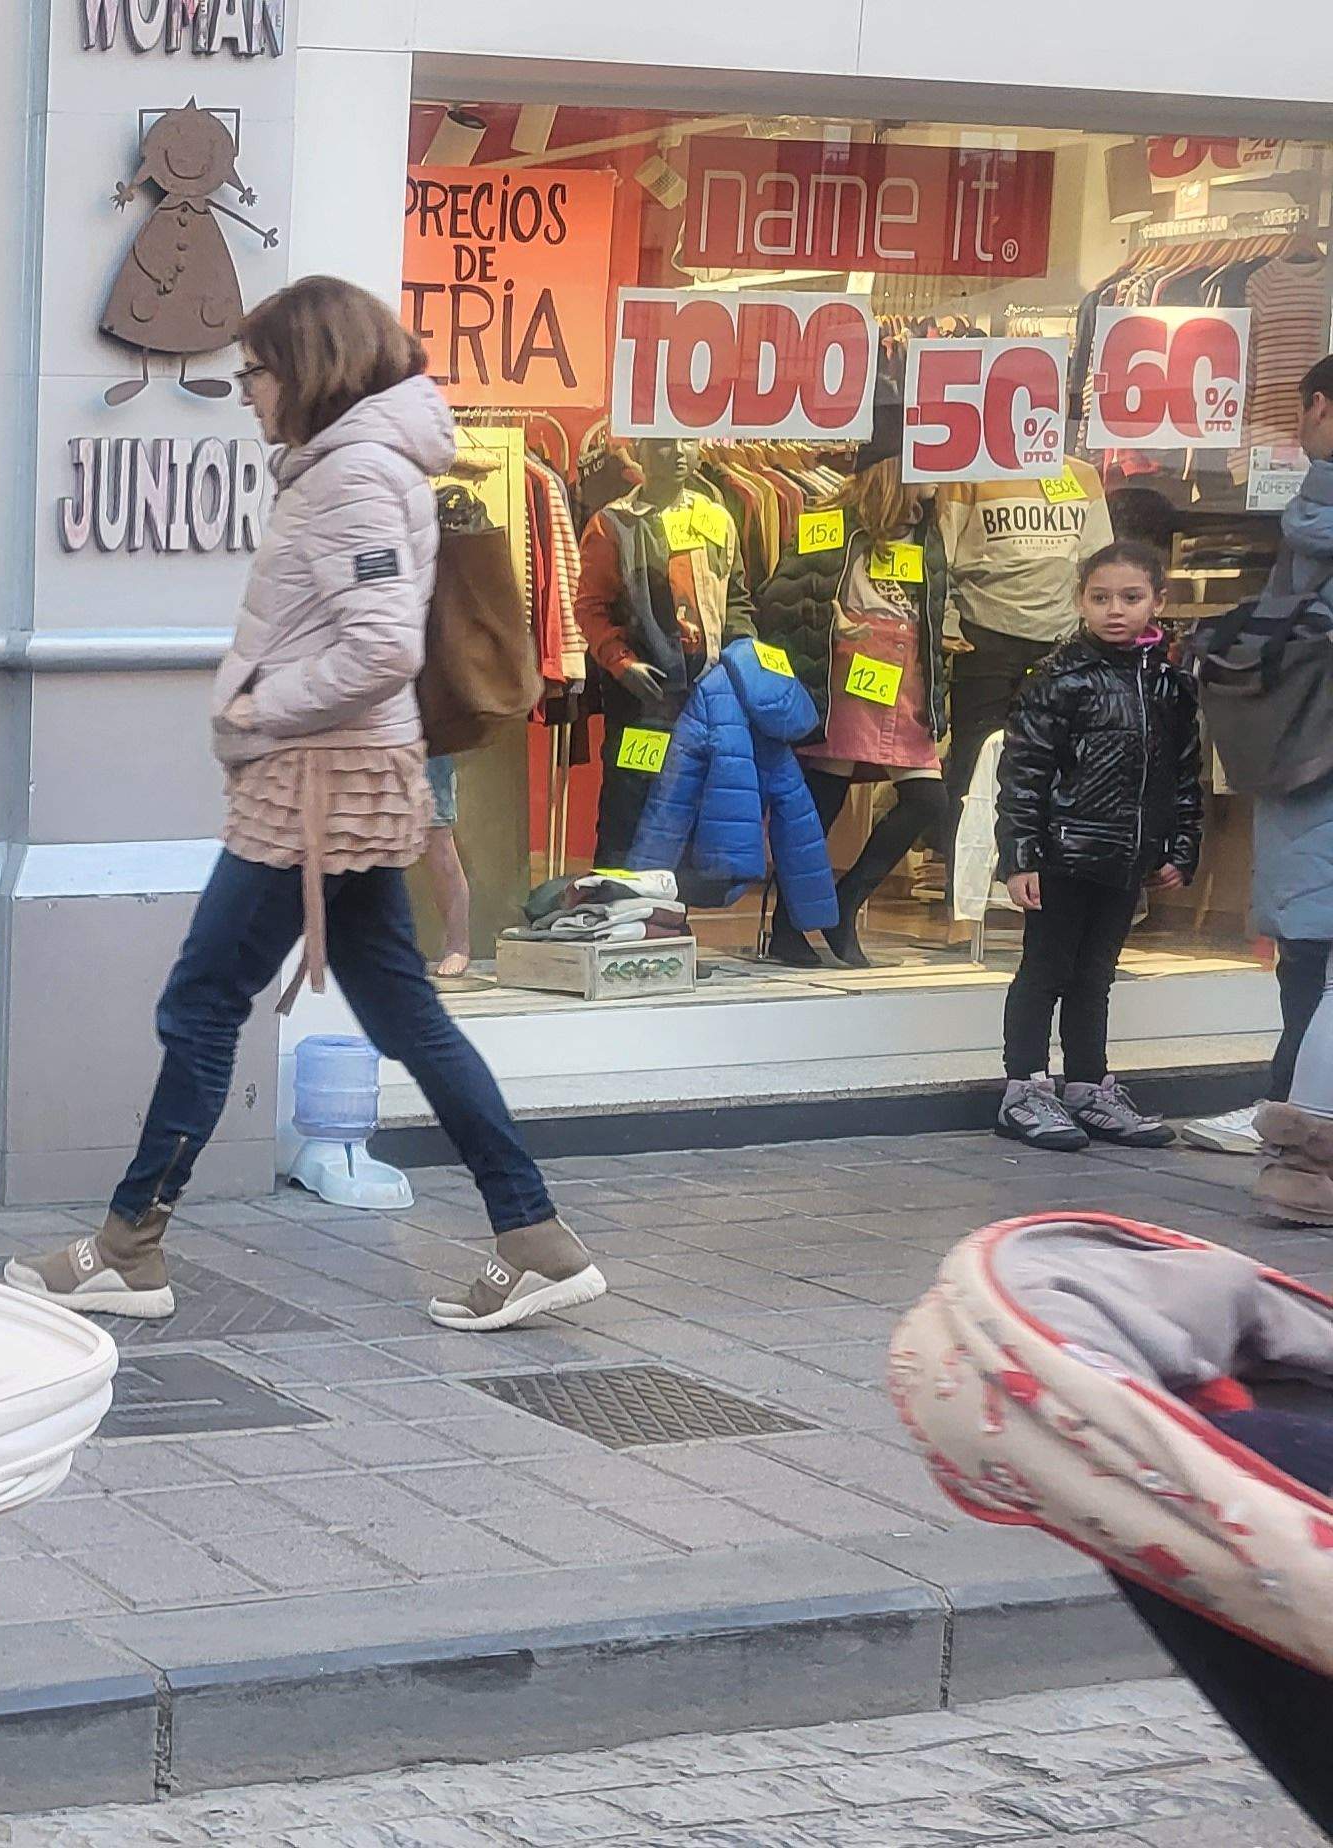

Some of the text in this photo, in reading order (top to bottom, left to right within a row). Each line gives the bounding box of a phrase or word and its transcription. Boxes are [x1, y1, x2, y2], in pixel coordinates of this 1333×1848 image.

[699, 169, 919, 259] name
[453, 244, 497, 282] DE
[622, 300, 869, 428] TODO
[1024, 451, 1057, 464] DTO.
[58, 438, 265, 551] JUNIOR
[853, 667, 889, 698] 12€
